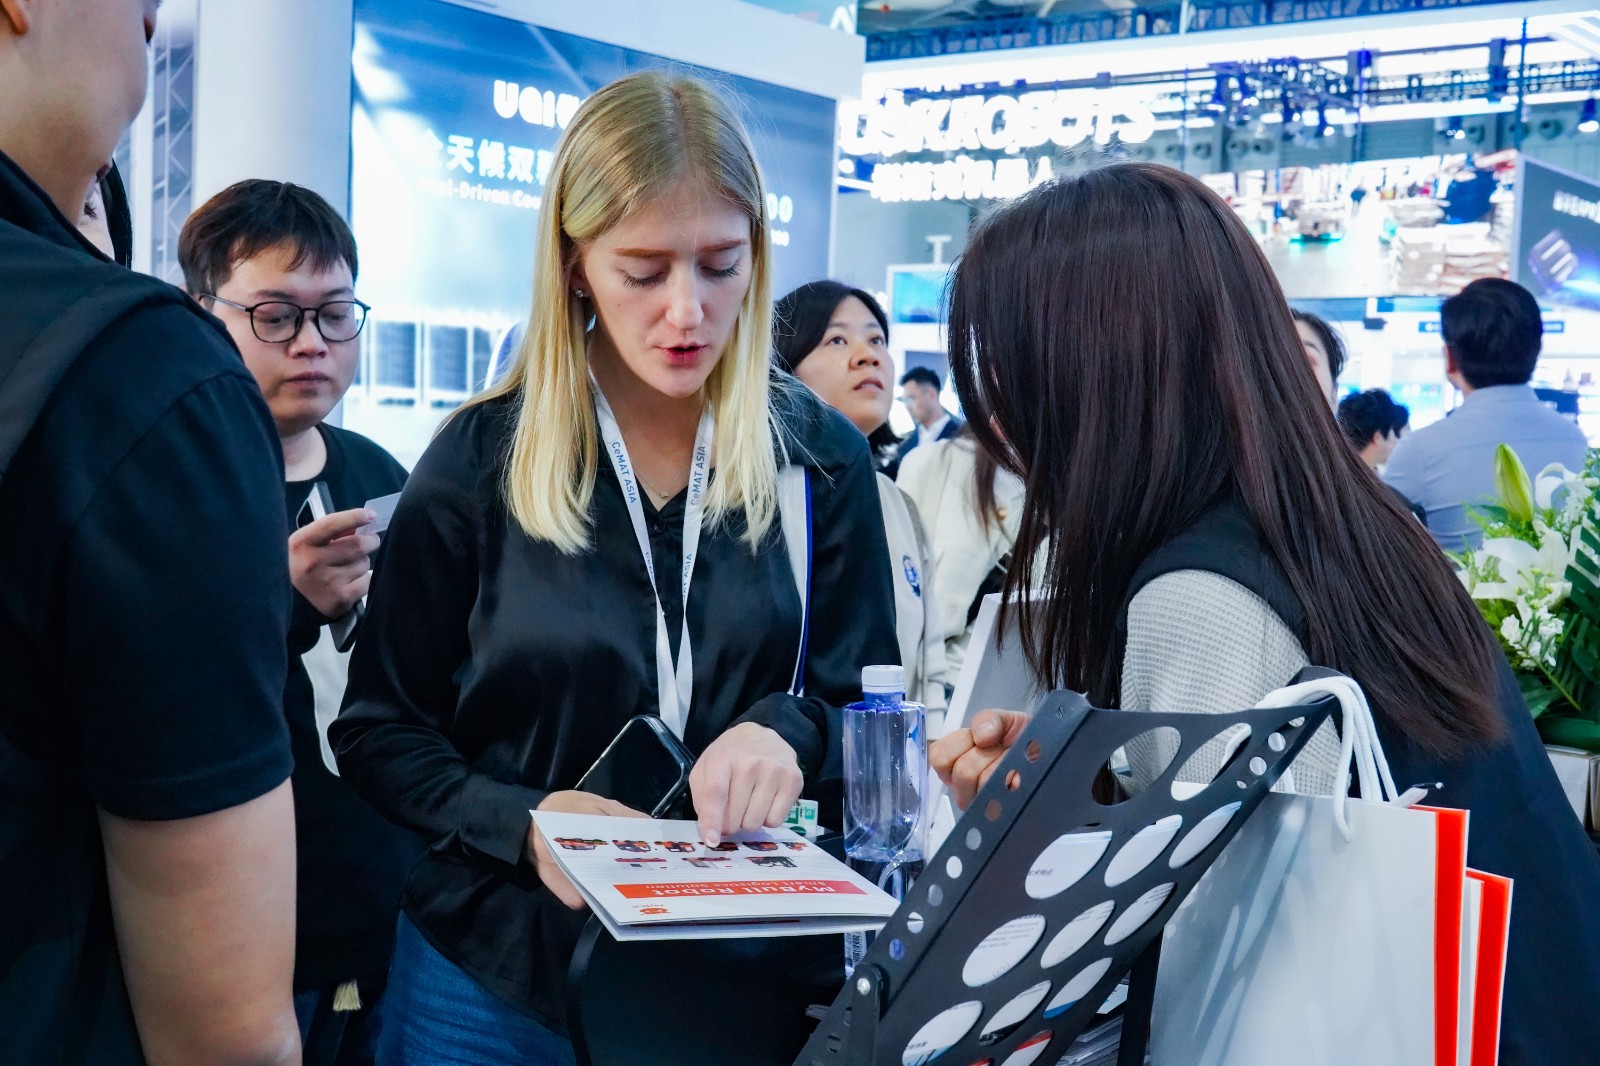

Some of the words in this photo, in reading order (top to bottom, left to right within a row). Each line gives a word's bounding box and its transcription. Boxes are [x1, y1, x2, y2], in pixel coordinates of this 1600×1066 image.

[611, 441, 630, 476] CeMAT
[624, 479, 637, 504] ASIA
[690, 470, 702, 506] CeMAT
[698, 446, 706, 469] ASIA
[684, 553, 692, 578] ASIA
[652, 887, 736, 895] Robot
[741, 885, 836, 893] MyBull
